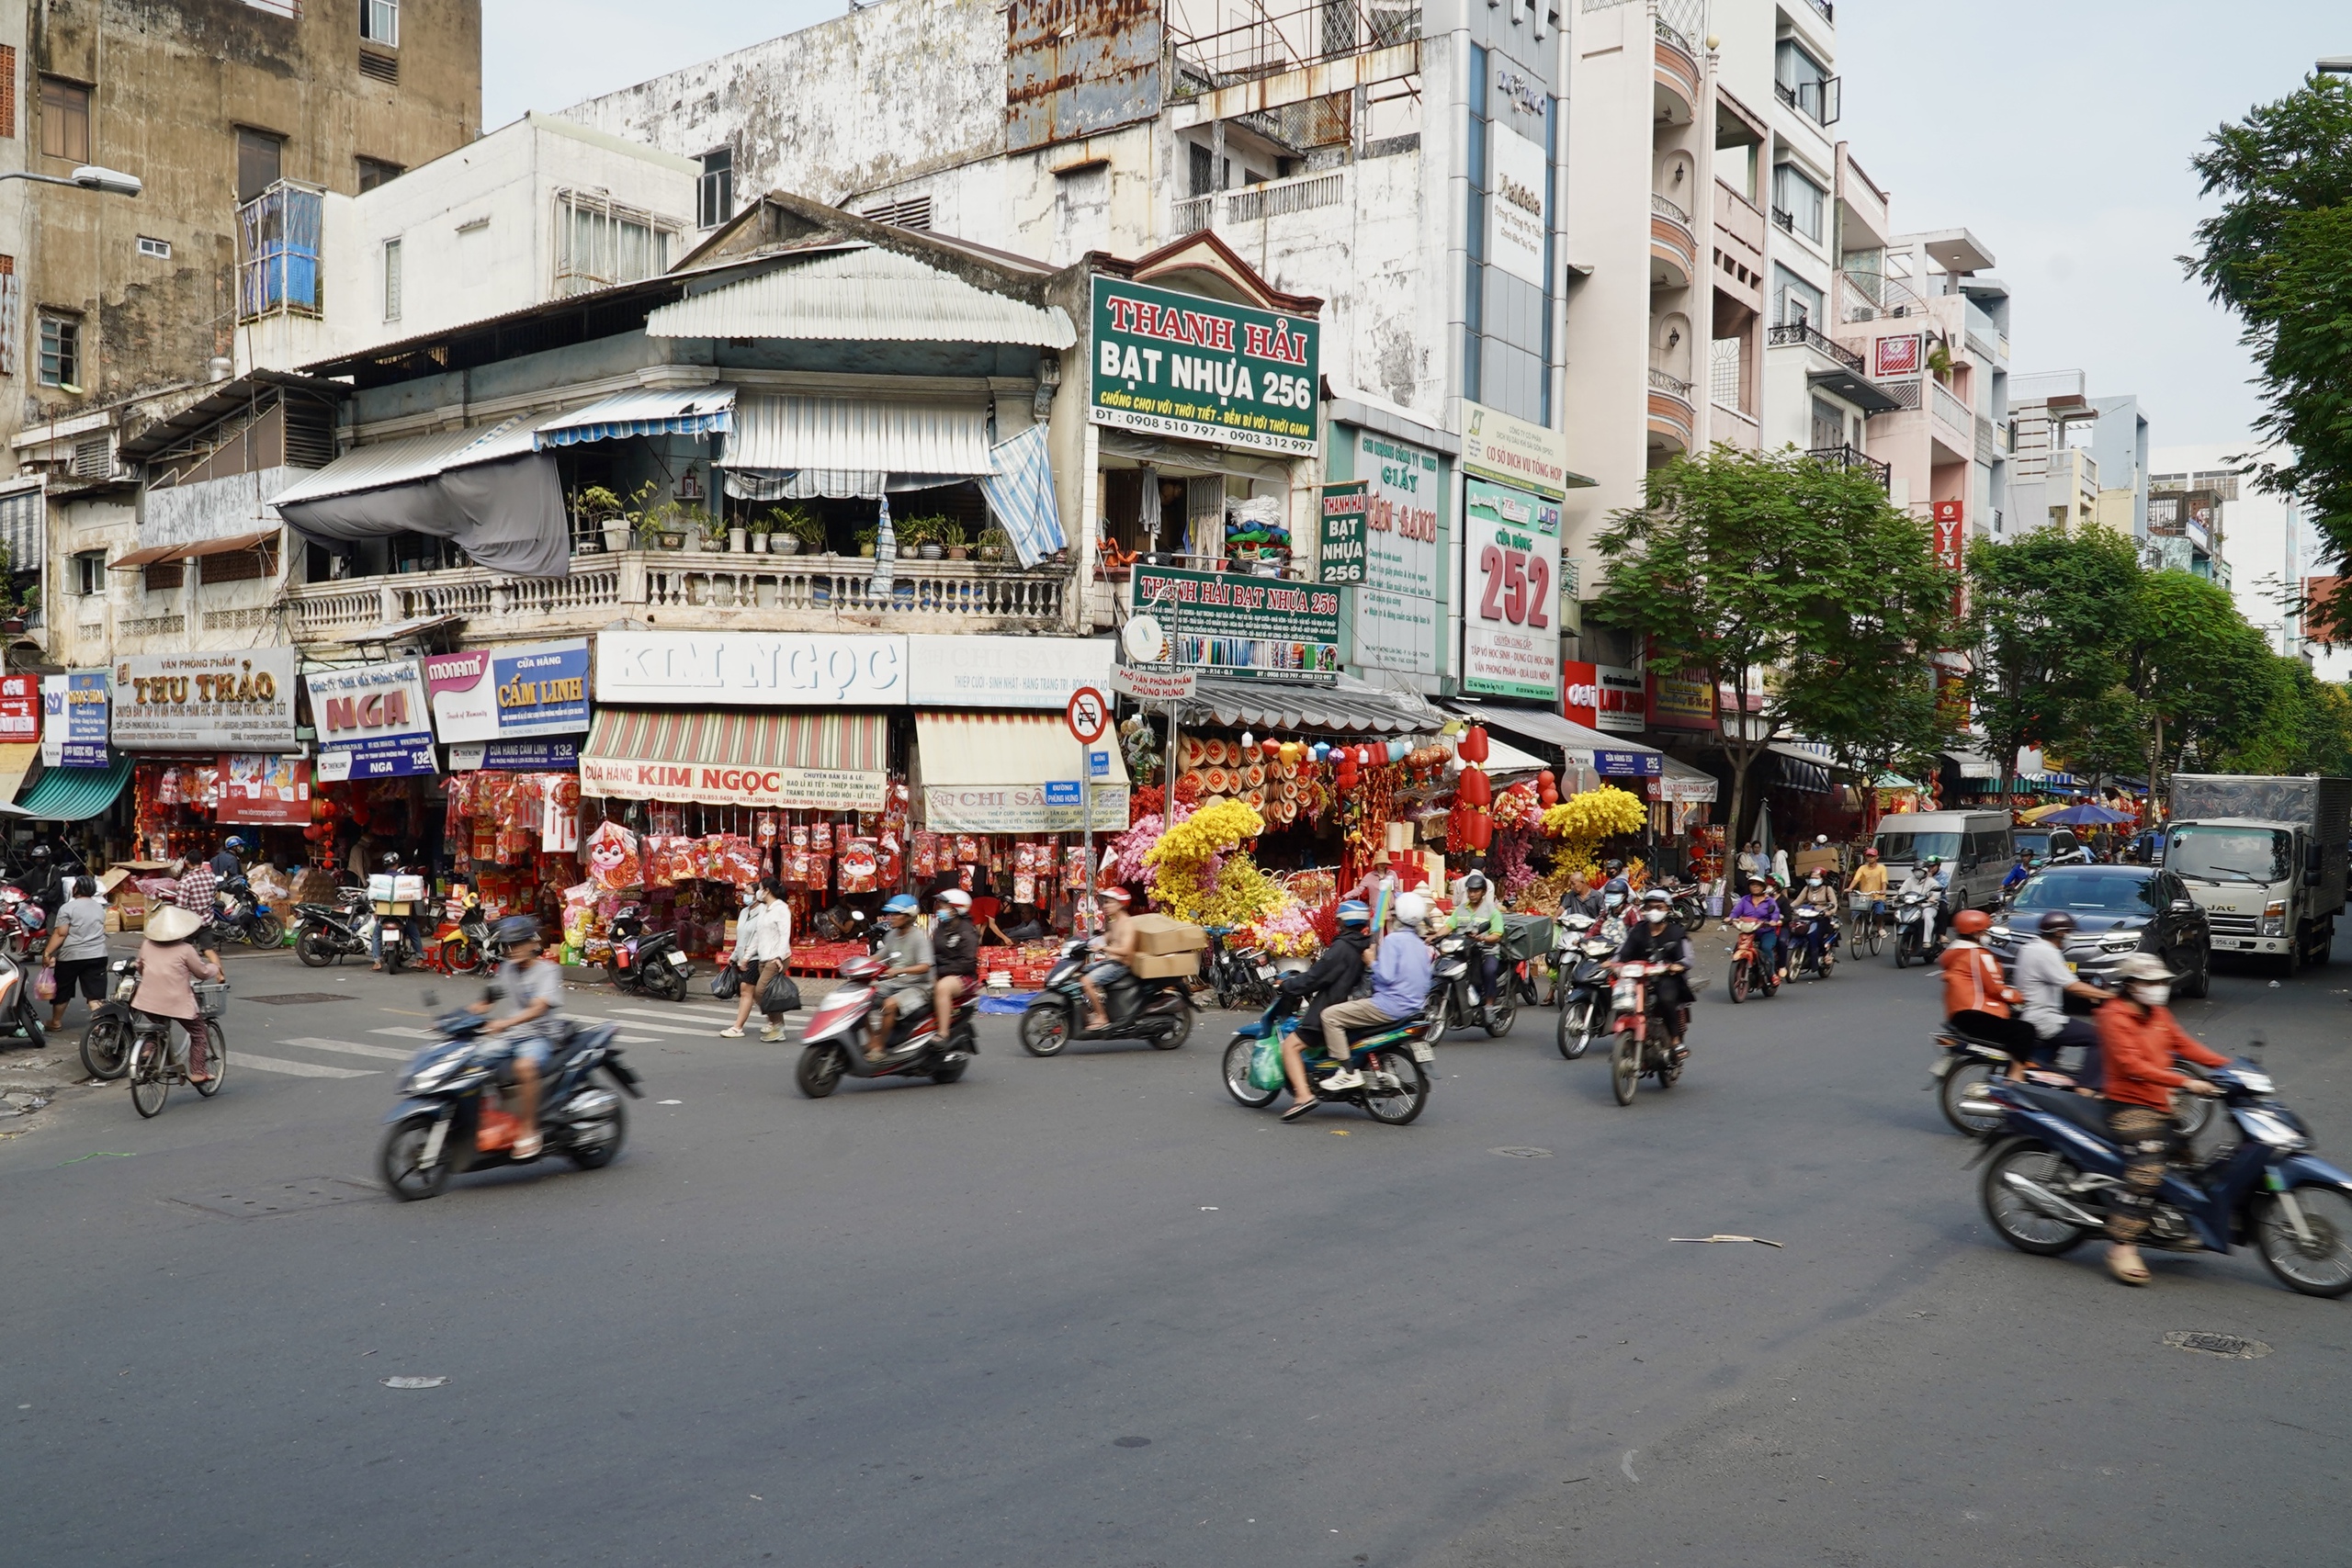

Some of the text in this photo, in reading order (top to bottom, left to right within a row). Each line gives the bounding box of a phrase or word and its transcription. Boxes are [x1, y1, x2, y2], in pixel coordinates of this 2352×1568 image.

[1106, 295, 1308, 367] THANH HẢI
[1100, 341, 1311, 410] BẠT NHỰA 256
[1101, 389, 1132, 408] CHỐNG
[1133, 396, 1156, 412] CHỌI
[1157, 400, 1172, 414] VỚI
[1174, 402, 1196, 418] THỜI
[1197, 404, 1217, 422] TIẾT
[1224, 410, 1240, 424] BỀN
[1253, 415, 1268, 430] VỚI
[1269, 418, 1288, 434] THỜI
[1289, 423, 1310, 436] GIAN
[1095, 410, 1313, 452] ĐT 0908 510 797 0903 312 997
[1412, 452, 1419, 468] TY
[1487, 446, 1496, 460] CƠ
[1497, 445, 1506, 465] SỞ
[1507, 453, 1521, 470] DỊCH
[1522, 457, 1531, 476] VỤ
[1532, 456, 1549, 478] TỔNG
[1550, 466, 1563, 484] HỢP
[1383, 465, 1419, 493] GIẤY
[1323, 487, 1366, 516] THANH HẢI
[1329, 519, 1359, 540] BẠT
[1398, 504, 1437, 544] SANH
[1323, 539, 1363, 563] NHỰA
[1324, 564, 1362, 581] 256
[1200, 575, 1230, 605] HẢI
[1233, 584, 1265, 613] BẠT
[1267, 588, 1309, 616] NHỰA
[1311, 592, 1338, 615] 256
[1480, 546, 1550, 628] 252
[161, 653, 236, 670] VĂN PHÒNG PHẨM
[517, 656, 561, 669] CỬA HÀNG
[1488, 650, 1498, 660] HỌC
[1499, 650, 1510, 660] SINH
[1513, 652, 1526, 663] DỤNG
[1534, 655, 1544, 666] HỌC
[1544, 657, 1555, 666] SINH
[612, 642, 901, 699] KIM NGỌC
[1135, 673, 1148, 683] VĂN
[1149, 675, 1172, 686] PHÒNG
[1174, 674, 1192, 685] PHẨM
[1475, 662, 1485, 672] VĂN
[1486, 663, 1502, 675] PHÒNG
[1502, 663, 1516, 676] PHẨM
[1520, 669, 1530, 680] QUÀ
[133, 659, 277, 705] THU THẢO
[540, 676, 584, 704] LINH
[989, 676, 1002, 689] SINH
[1040, 678, 1058, 691] TRANG
[1132, 685, 1185, 696] PHÙNG HƯNG
[1568, 683, 1596, 707] deli
[326, 689, 410, 731] NGA
[553, 744, 573, 756] 132
[369, 761, 393, 773] NGA
[804, 772, 827, 780] CHUYÊN
[585, 761, 781, 796] CỬA HÀNG KIM NGỌC
[1052, 783, 1074, 792] ĐƯỜNG
[1647, 782, 1661, 795] deli
[959, 788, 1046, 810] CHỊ SÂ
[1047, 793, 1079, 804] PHÙNG HƯNG
[2207, 904, 2236, 912] JAC
